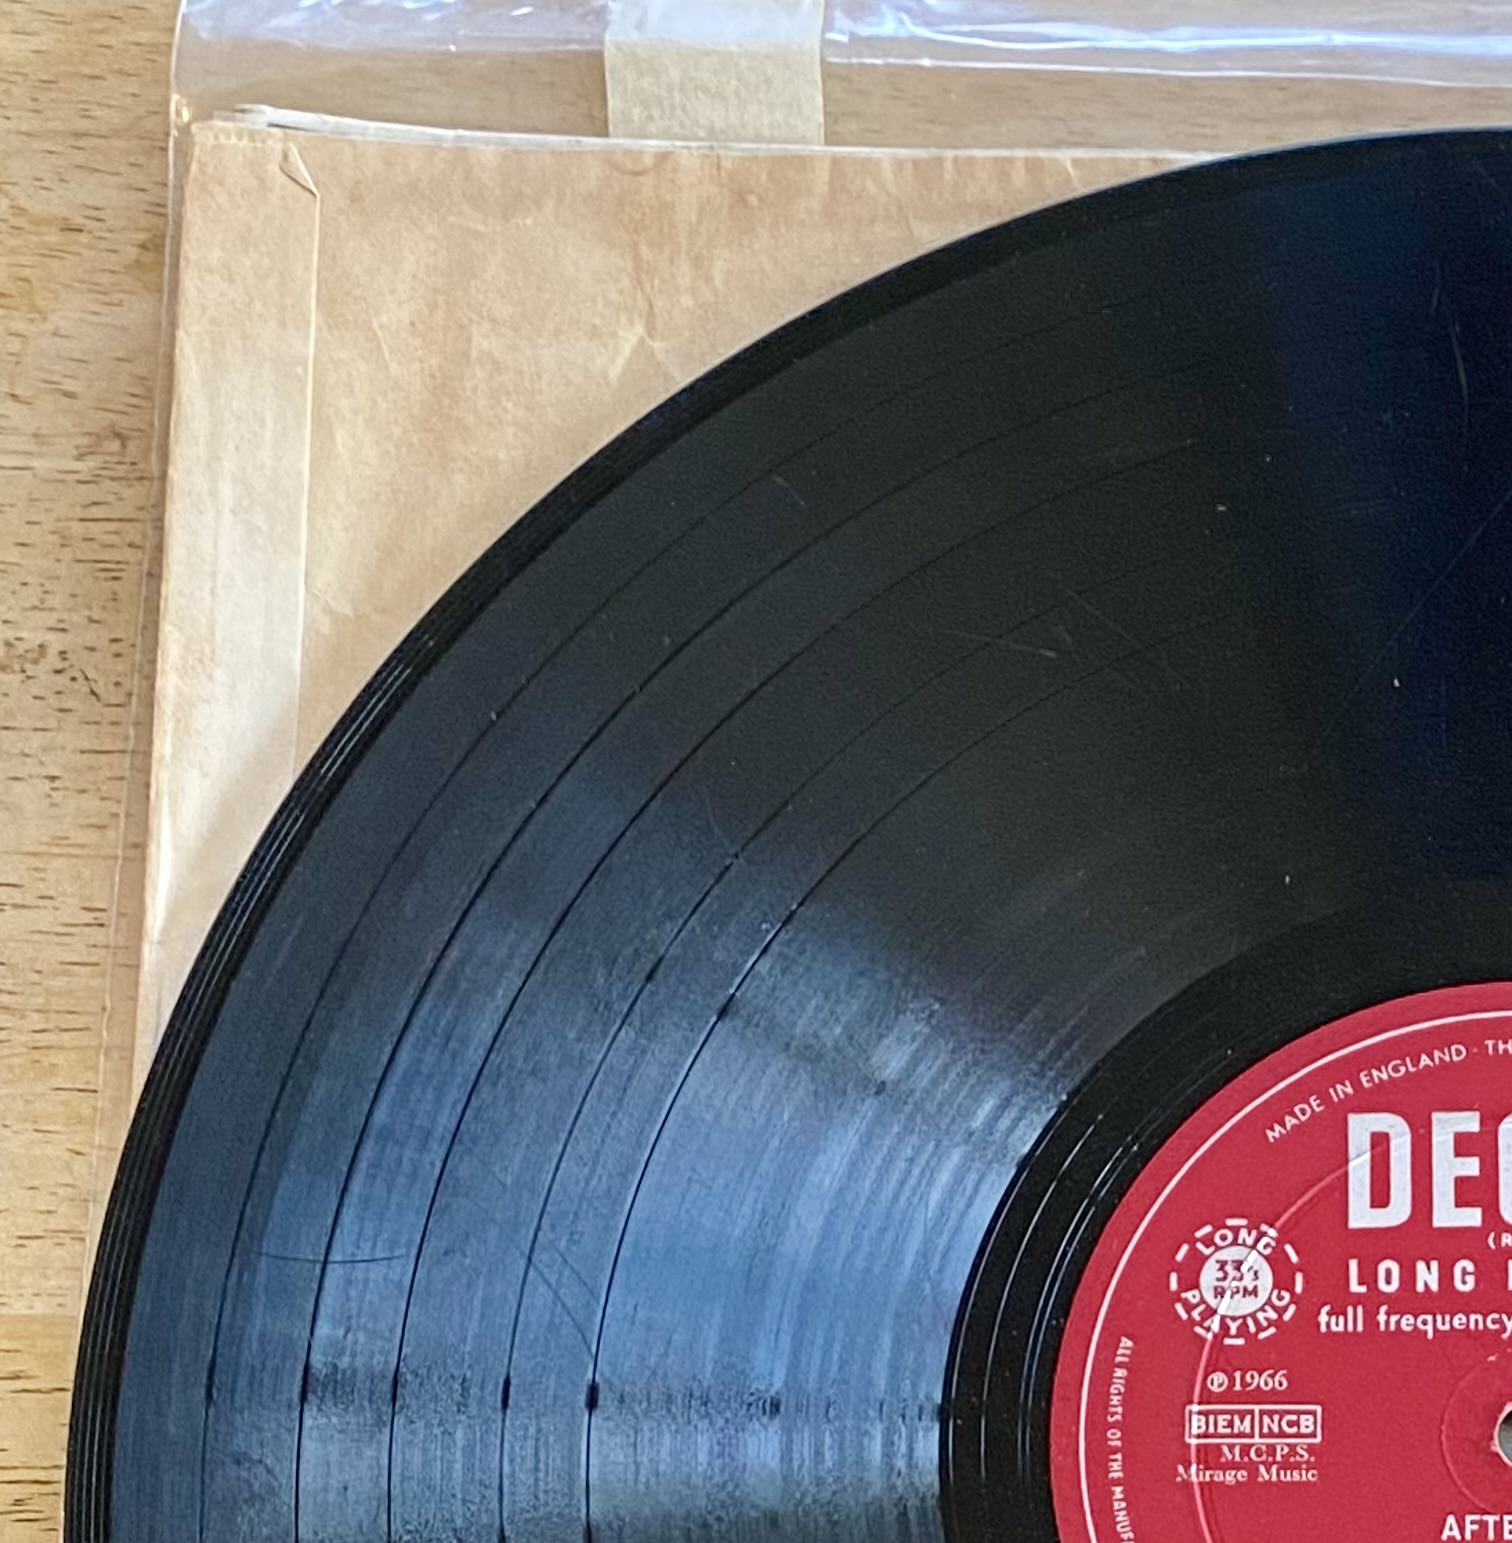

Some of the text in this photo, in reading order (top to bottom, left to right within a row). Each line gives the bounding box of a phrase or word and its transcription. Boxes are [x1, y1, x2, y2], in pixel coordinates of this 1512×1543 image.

[1265, 1094, 1324, 1142] MADE
[1329, 1080, 1353, 1102] IN
[1360, 1044, 1467, 1088] ENGLAND
[1196, 1227, 1276, 1256] LONG
[1348, 1257, 1476, 1293] LONG
[1213, 1285, 1258, 1299] RPM
[1180, 1289, 1291, 1336] PLAYING
[1318, 1305, 1363, 1332] full
[1114, 1336, 1134, 1363] ALL
[1107, 1367, 1128, 1422] RIGHTS
[1107, 1428, 1121, 1447] OF
[1191, 1414, 1315, 1434] BIEM NCB
[1108, 1452, 1124, 1479] THE
[1220, 1444, 1315, 1463] M.C.P.S.
[1175, 1463, 1317, 1485] Mirage Music
